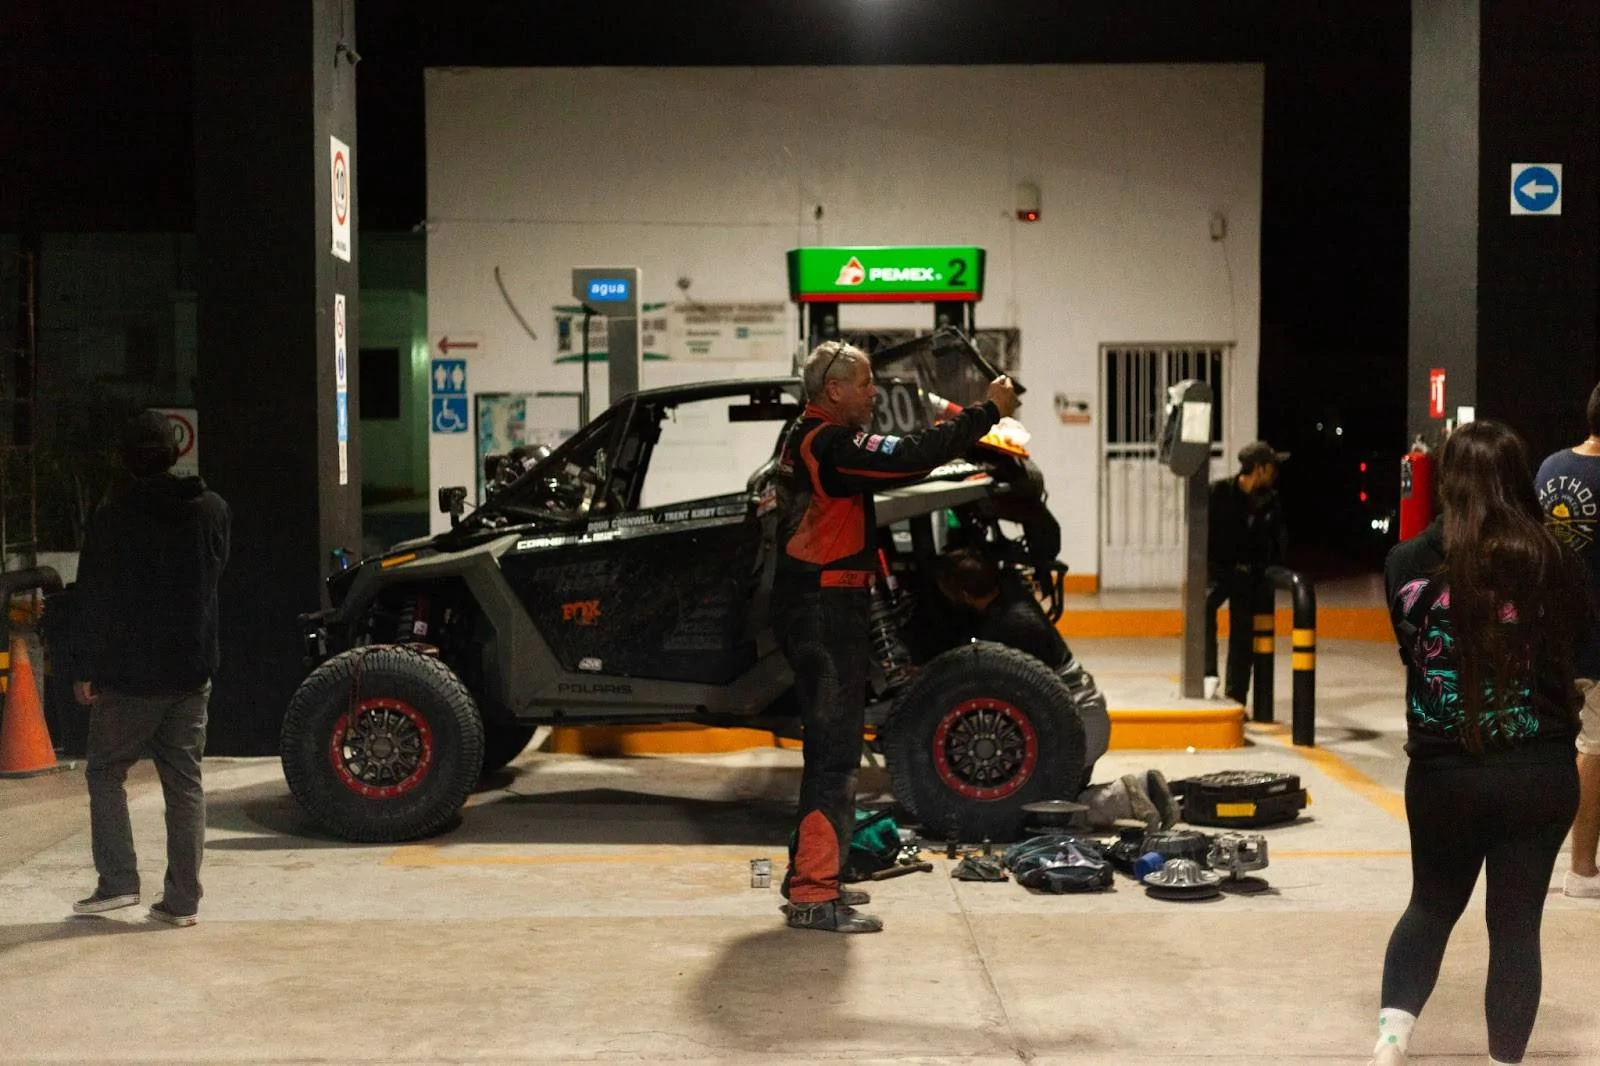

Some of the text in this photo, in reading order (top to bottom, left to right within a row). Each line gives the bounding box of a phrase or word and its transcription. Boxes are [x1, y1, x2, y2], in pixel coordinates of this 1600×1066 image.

[869, 267, 934, 282] PEMEX
[947, 259, 967, 286] 2
[591, 280, 626, 296] agua
[861, 386, 914, 432] 30
[611, 515, 654, 530] CORNWELL
[664, 510, 689, 522] TRENT
[691, 507, 716, 519] KIRBY
[561, 599, 601, 625] FOX
[558, 683, 633, 694] POLARIS
